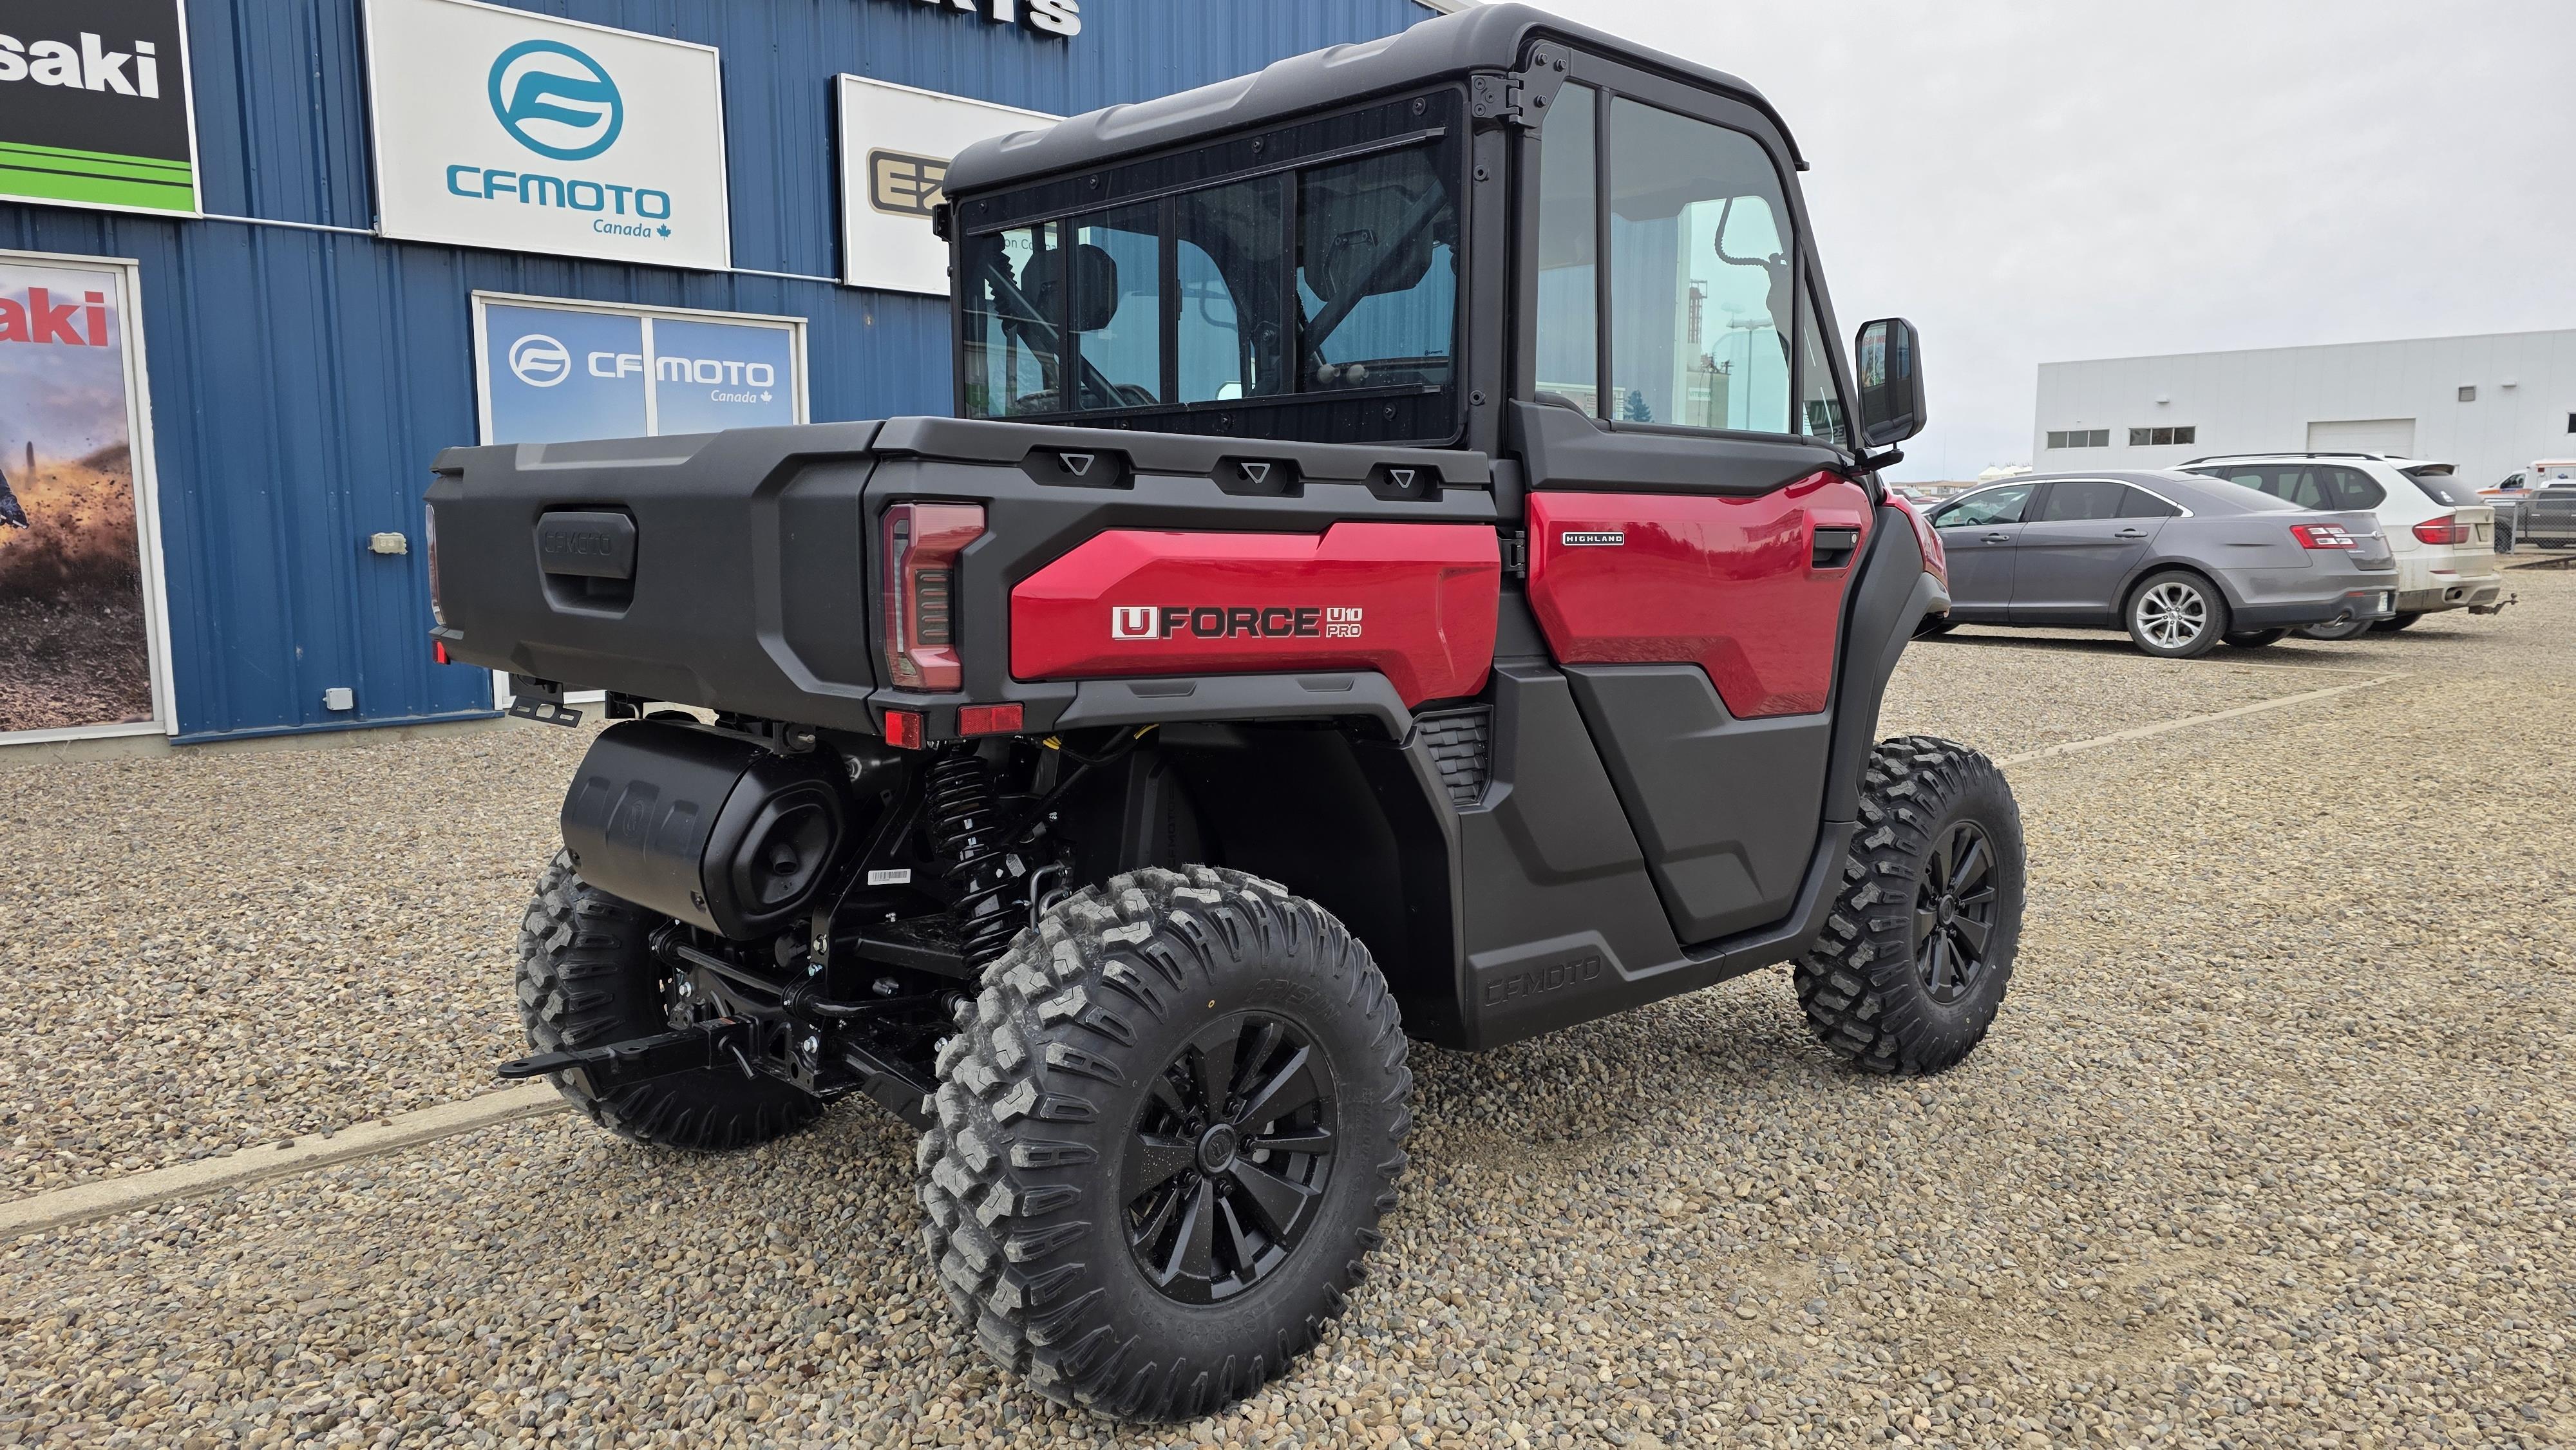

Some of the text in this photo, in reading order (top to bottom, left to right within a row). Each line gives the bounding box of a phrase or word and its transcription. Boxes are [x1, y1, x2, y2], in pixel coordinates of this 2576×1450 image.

[446, 164, 670, 220] CFMOTO
[593, 219, 652, 238] Canada
[588, 352, 774, 387] CFMOTO
[710, 390, 757, 403] Canada
[545, 531, 611, 556] CFMOTO
[1327, 607, 1362, 622] U10
[1326, 624, 1361, 638] PRO
[1484, 954, 1600, 1007] CFMOTO
